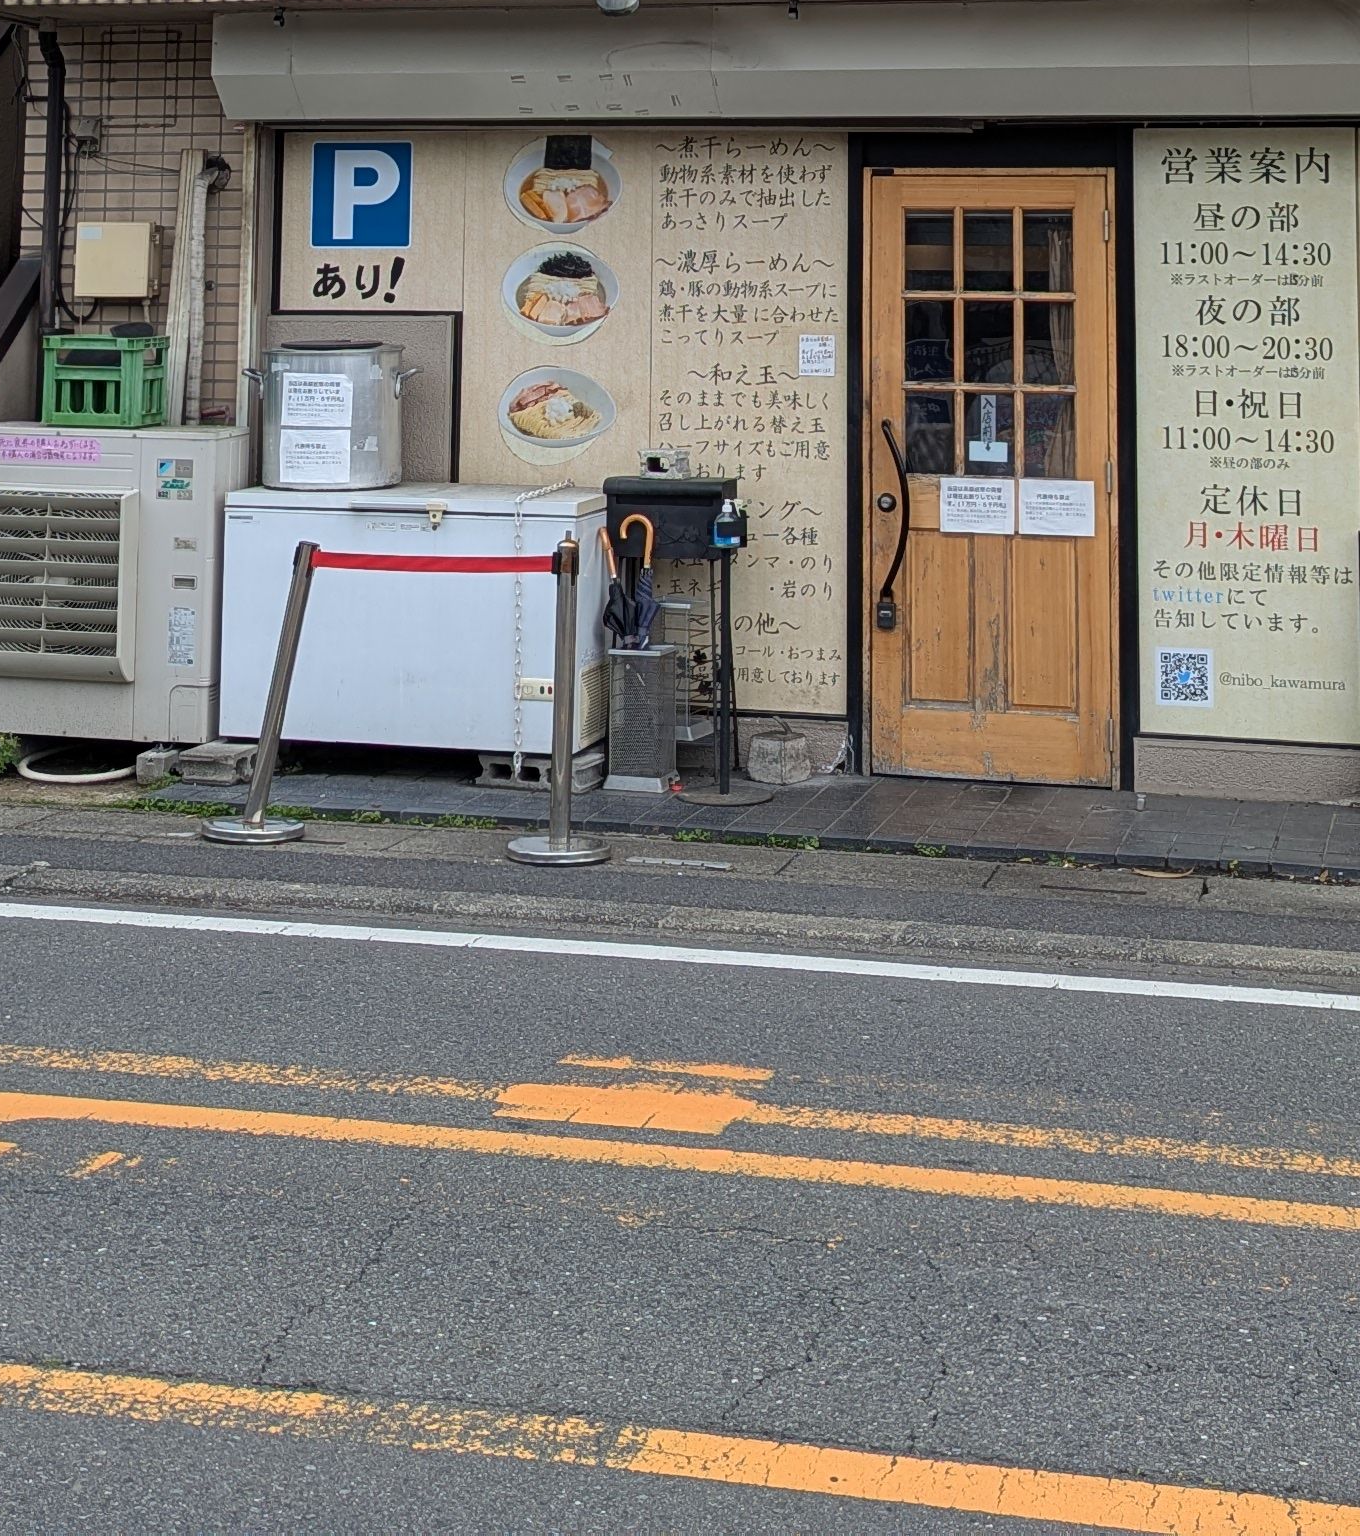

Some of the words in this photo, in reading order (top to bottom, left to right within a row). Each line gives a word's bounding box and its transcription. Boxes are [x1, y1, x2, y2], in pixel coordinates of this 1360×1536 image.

[659, 164, 832, 185] 動物系素材を使わず
[1161, 147, 1332, 185] 営業案内
[333, 150, 400, 240] P
[659, 188, 832, 208] 煮干のみで抽出した
[661, 213, 788, 232] あっさりスープ
[1193, 202, 1300, 233] 昼の部
[313, 256, 406, 304] あり!
[658, 282, 837, 299] 鶏・豚の動物系スープに
[658, 305, 840, 324] 煮干を大量に合わせた
[1195, 295, 1301, 327] 夜の部
[660, 329, 780, 346] こってりスープ
[658, 390, 830, 411] そのままでも美味しく
[1195, 389, 1303, 419] 日・祝日
[658, 412, 827, 434] 召し上がれる替え玉
[696, 463, 767, 482] おります
[1209, 456, 1290, 470] ※昼の部のみ
[1200, 484, 1302, 517] 定休日
[746, 526, 819, 546] ュー各種
[1184, 521, 1320, 552] 月・木曜日
[1153, 560, 1354, 585] その他限定情報等は
[1154, 610, 1320, 634] 告知しています。
[736, 645, 842, 661] コール・おつまみ
[1219, 671, 1346, 691] @nibo_kawamura
